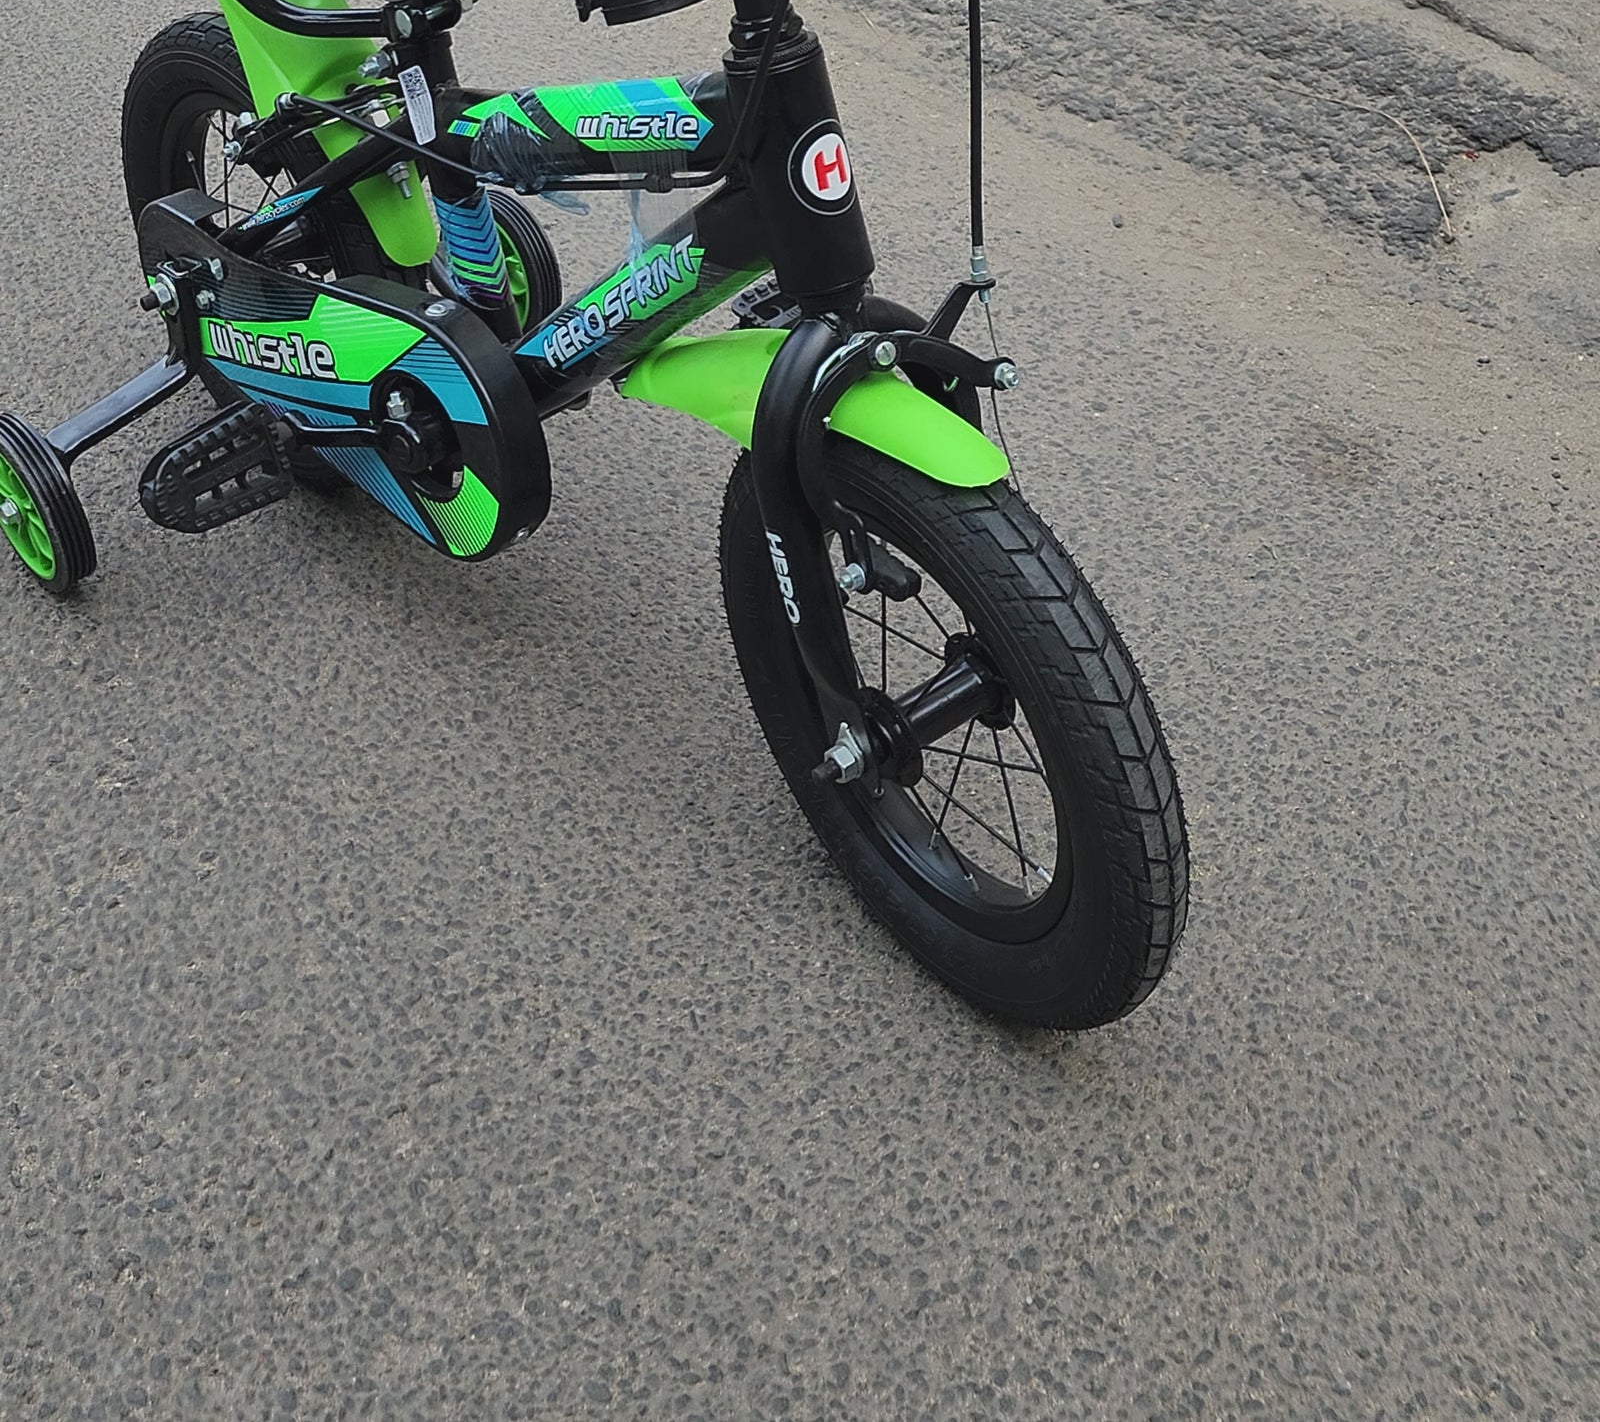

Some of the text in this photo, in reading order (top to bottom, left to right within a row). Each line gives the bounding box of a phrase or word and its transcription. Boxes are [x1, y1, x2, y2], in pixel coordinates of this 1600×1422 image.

[575, 112, 699, 139] whistle
[813, 143, 848, 191] H
[208, 321, 338, 379] whistle
[765, 530, 801, 625] HERO
